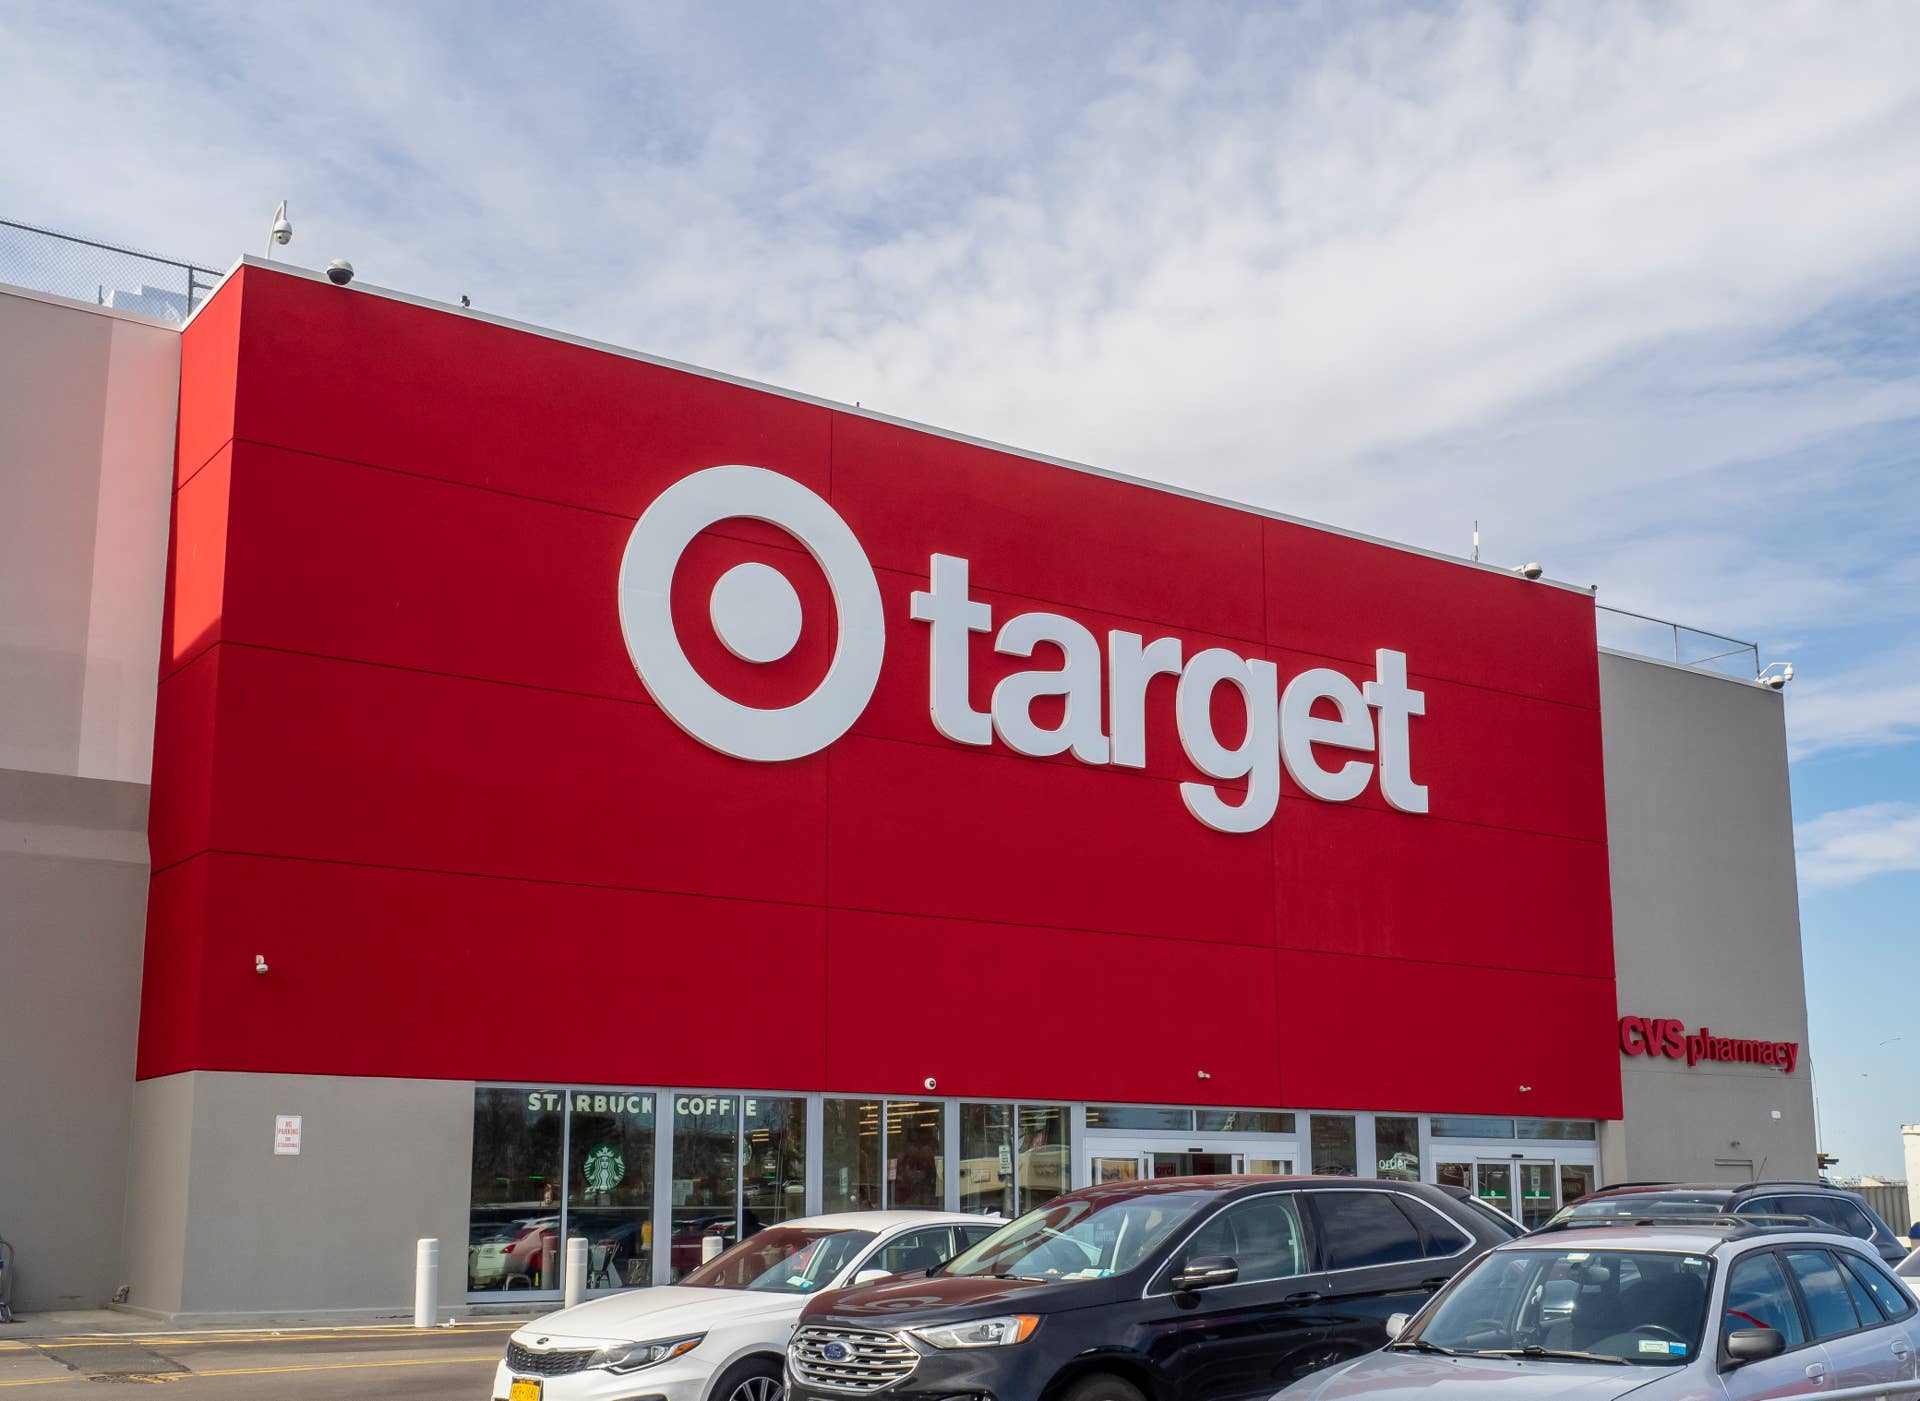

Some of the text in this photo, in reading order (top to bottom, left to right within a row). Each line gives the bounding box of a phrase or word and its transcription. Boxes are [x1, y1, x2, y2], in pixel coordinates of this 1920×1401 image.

[910, 553, 1428, 833] target
[1620, 1016, 1798, 1073] CVS pharmacy
[527, 1092, 757, 1116] STRBUCK COFFE
